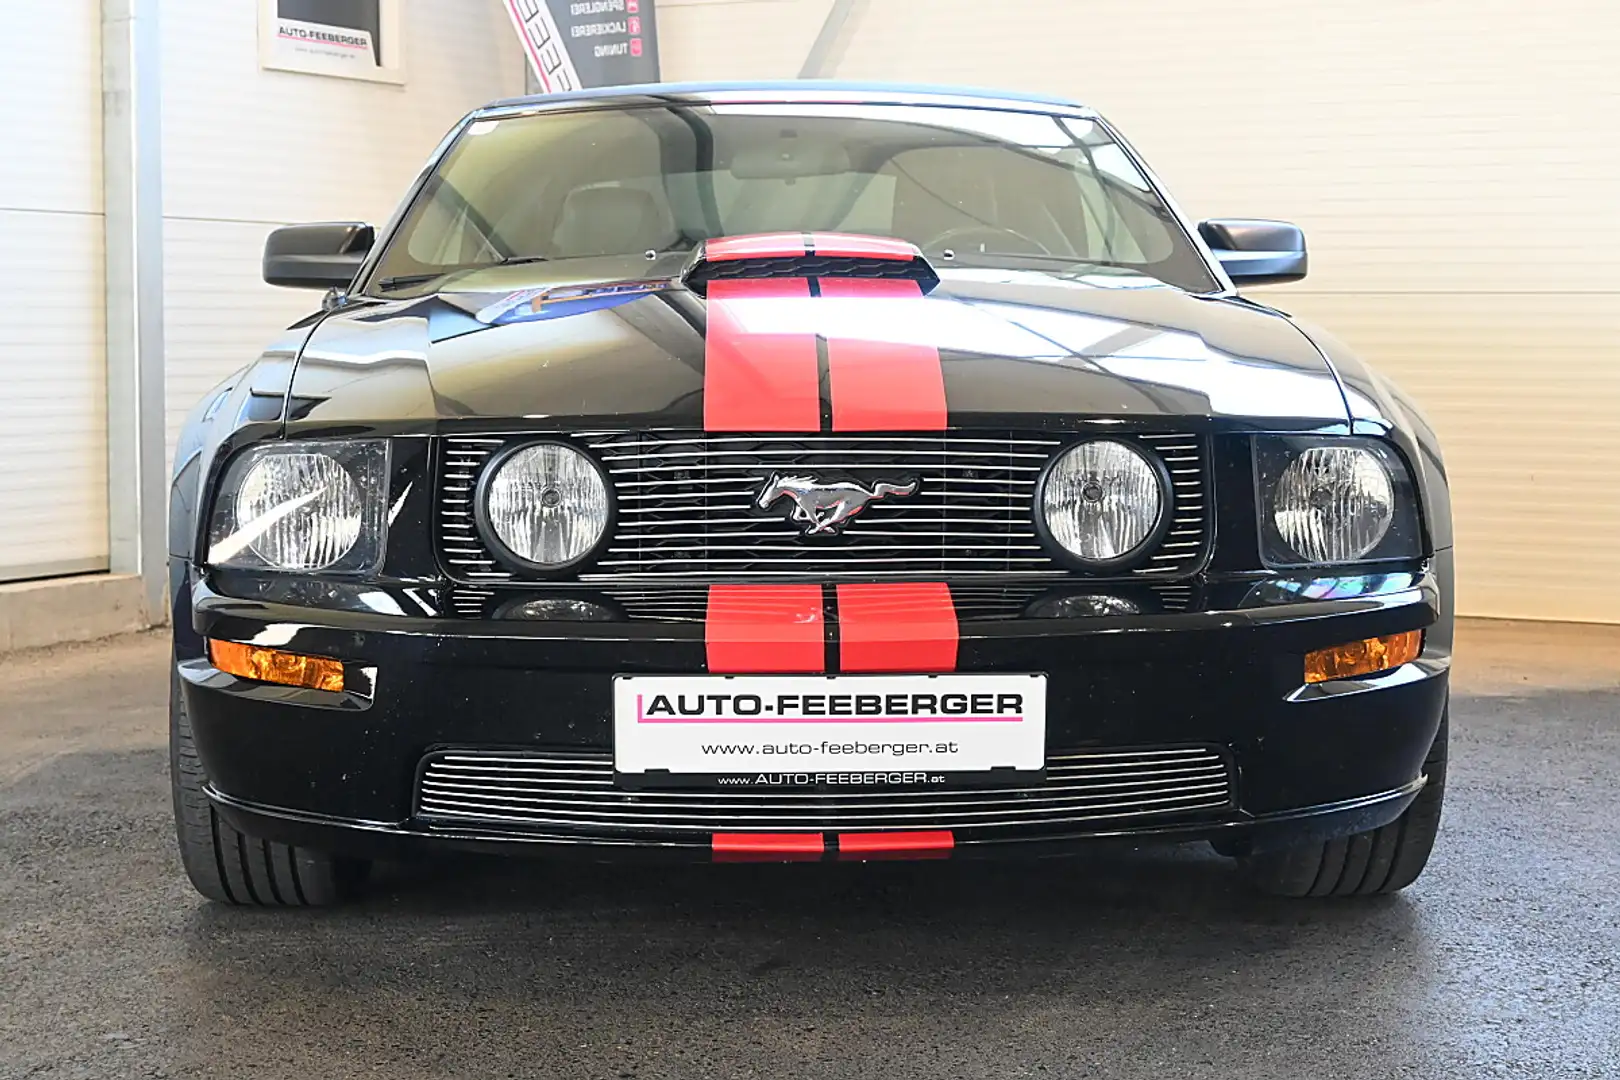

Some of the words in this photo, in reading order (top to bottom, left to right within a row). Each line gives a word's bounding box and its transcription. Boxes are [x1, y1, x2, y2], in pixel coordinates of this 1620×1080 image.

[278, 26, 368, 46] AUTO-FEEBERGER
[646, 693, 1023, 716] AUTO-FEEBERGER
[701, 740, 959, 756] www.auto-feeberger.at
[717, 772, 946, 786] www.AUTO-FEEBERGER.at
